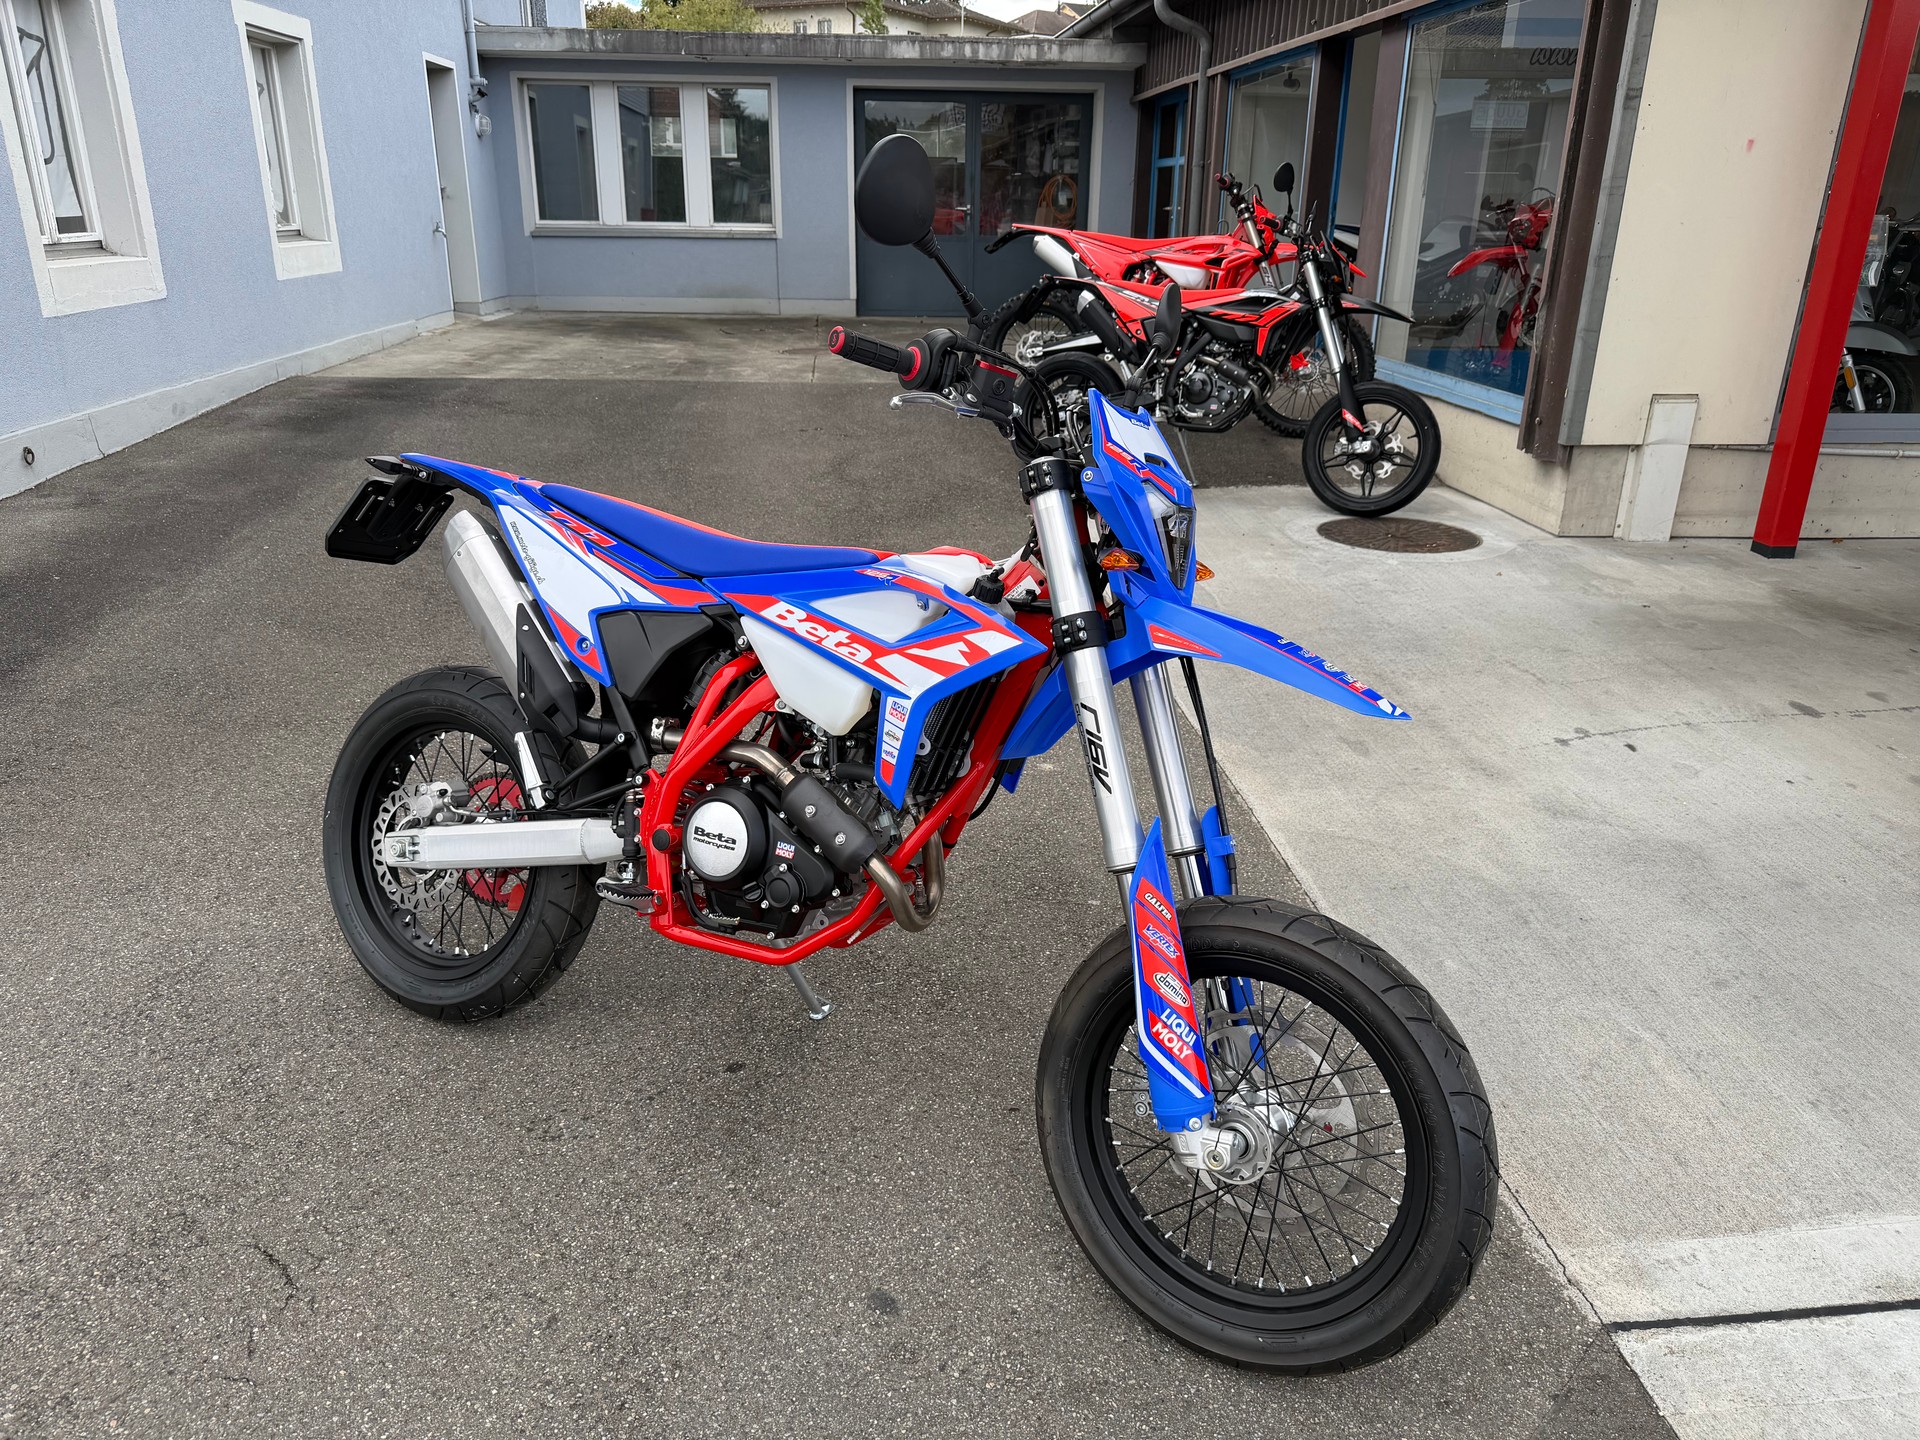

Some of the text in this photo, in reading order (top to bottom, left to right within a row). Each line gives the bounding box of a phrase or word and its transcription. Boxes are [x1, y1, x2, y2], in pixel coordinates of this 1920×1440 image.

[760, 601, 872, 664] Beta
[888, 707, 906, 722] MOLY
[692, 836, 736, 851] motorcycles
[693, 825, 737, 845] Beta
[776, 841, 796, 852] LIQUI
[775, 847, 795, 859] MOLY
[1144, 893, 1172, 921] GALFER
[1145, 924, 1178, 957] VERTEX
[1158, 973, 1188, 1005] domino
[1152, 1021, 1193, 1060] MOLY
[1160, 1008, 1196, 1046] LIQUI
